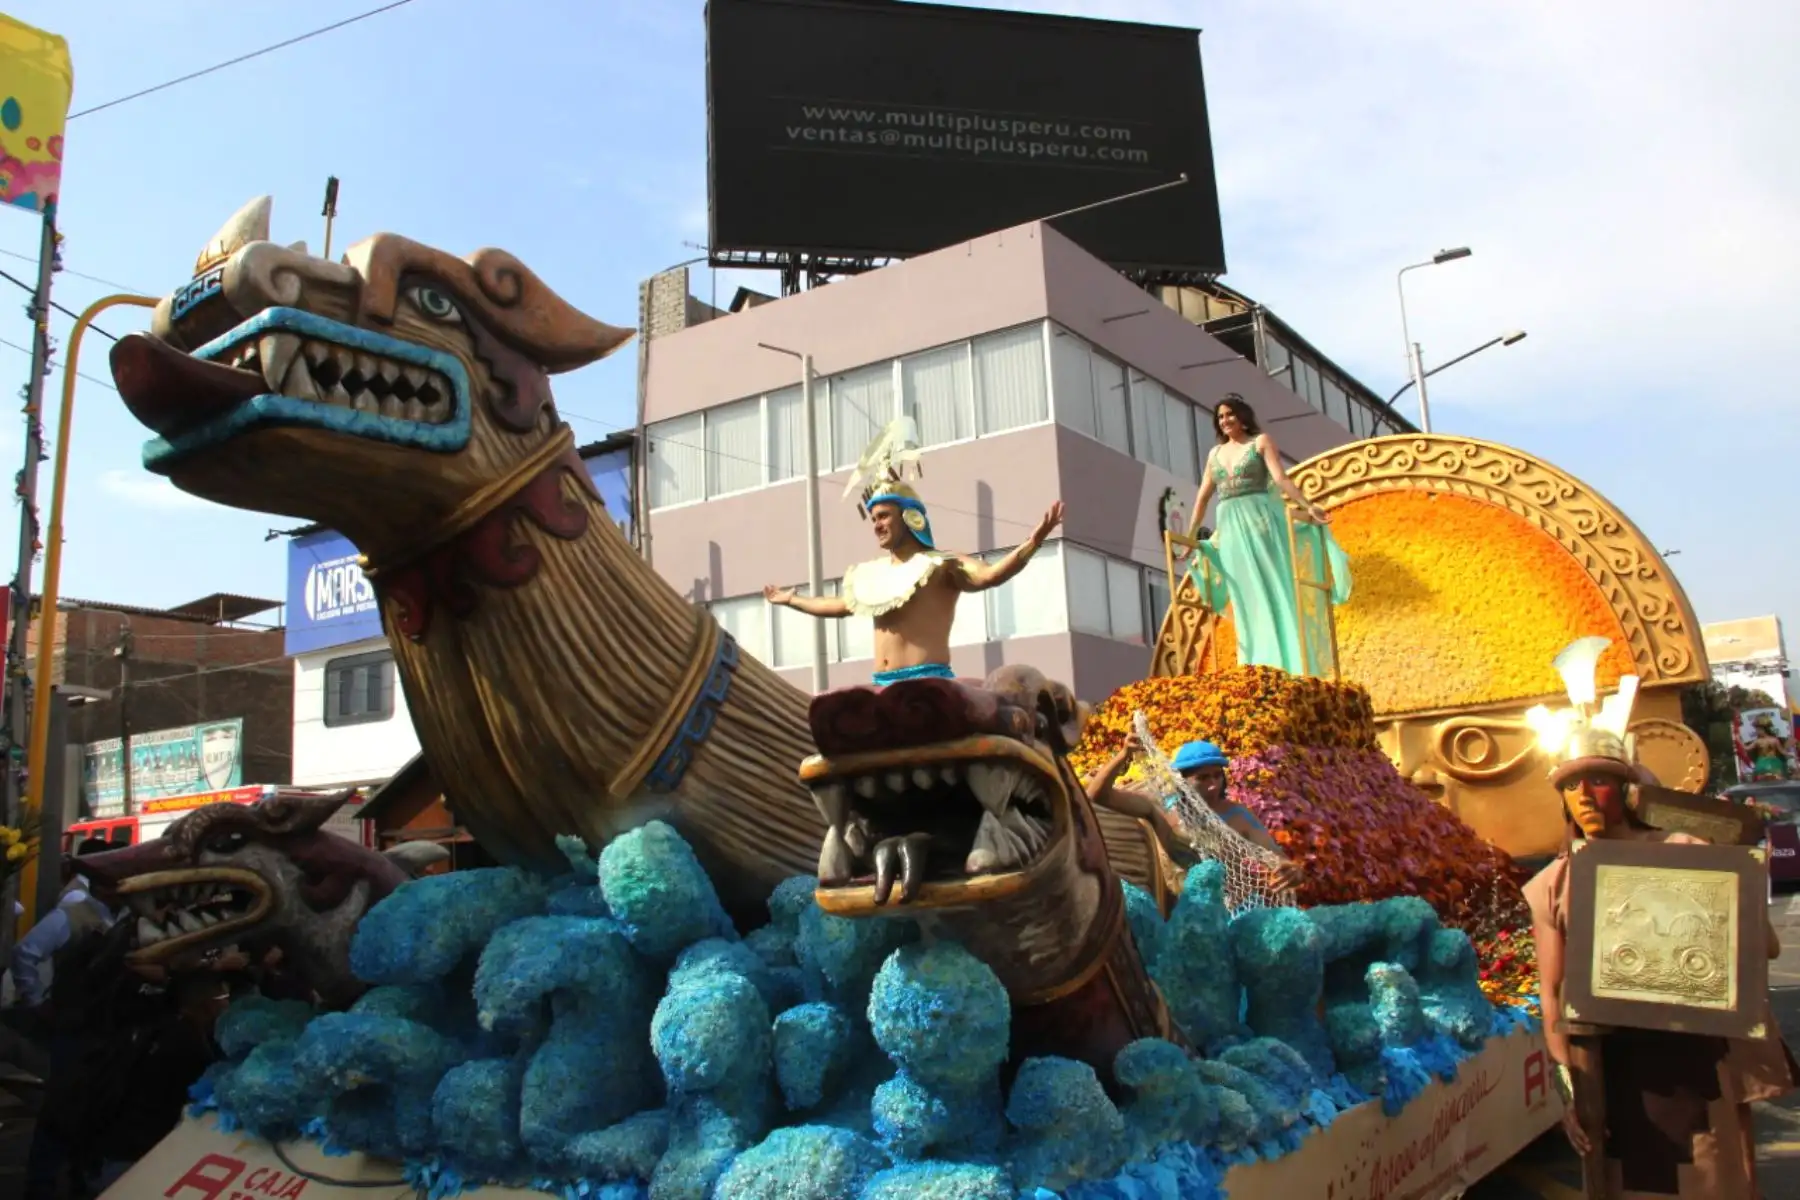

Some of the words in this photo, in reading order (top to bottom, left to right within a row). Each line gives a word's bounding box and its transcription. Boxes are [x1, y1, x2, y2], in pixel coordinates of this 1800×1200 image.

[802, 105, 1131, 141] www.multiplusperu.com
[786, 126, 1149, 163] ventas@multiplusperu.com
[244, 1167, 309, 1200] CAJA
